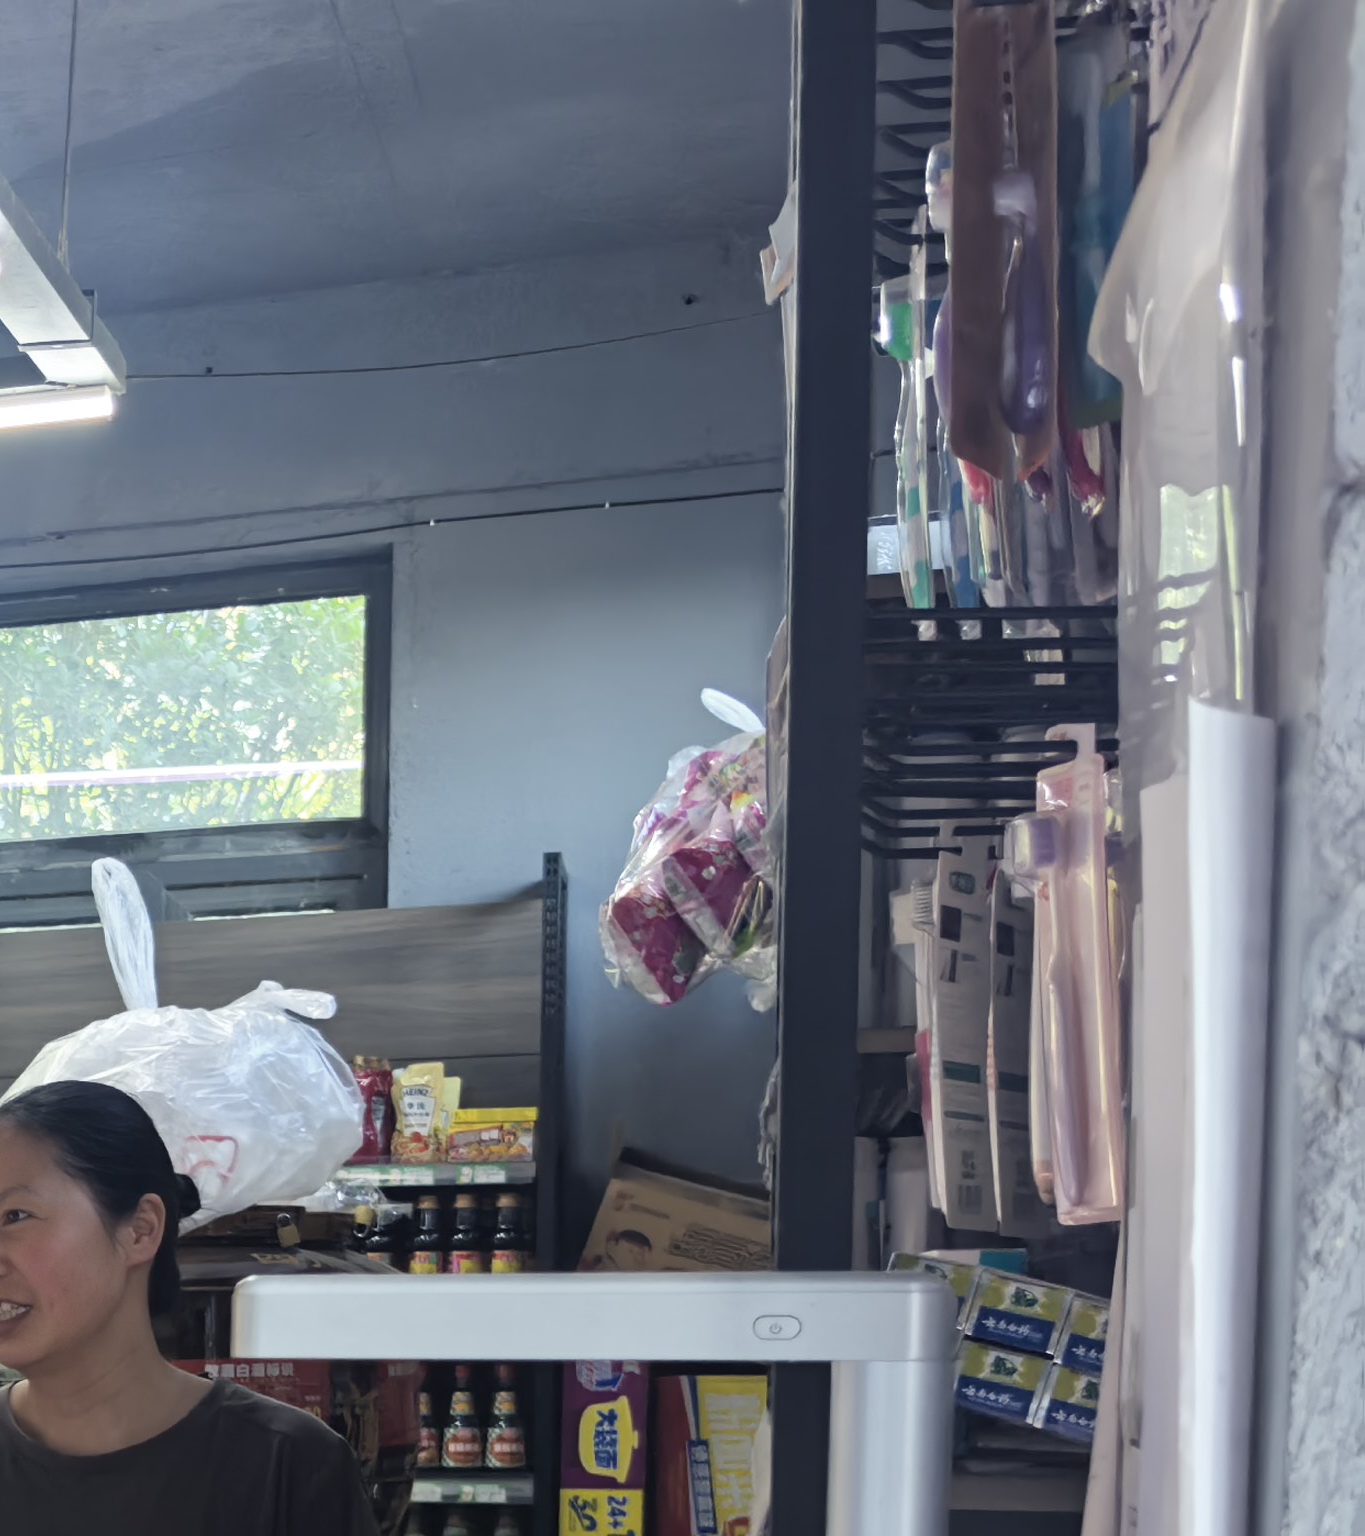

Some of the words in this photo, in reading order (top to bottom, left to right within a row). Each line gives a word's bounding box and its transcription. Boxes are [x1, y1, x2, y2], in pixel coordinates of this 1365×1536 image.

[982, 1315, 1030, 1336] 云南白药
[961, 1384, 1011, 1404] 云南白药
